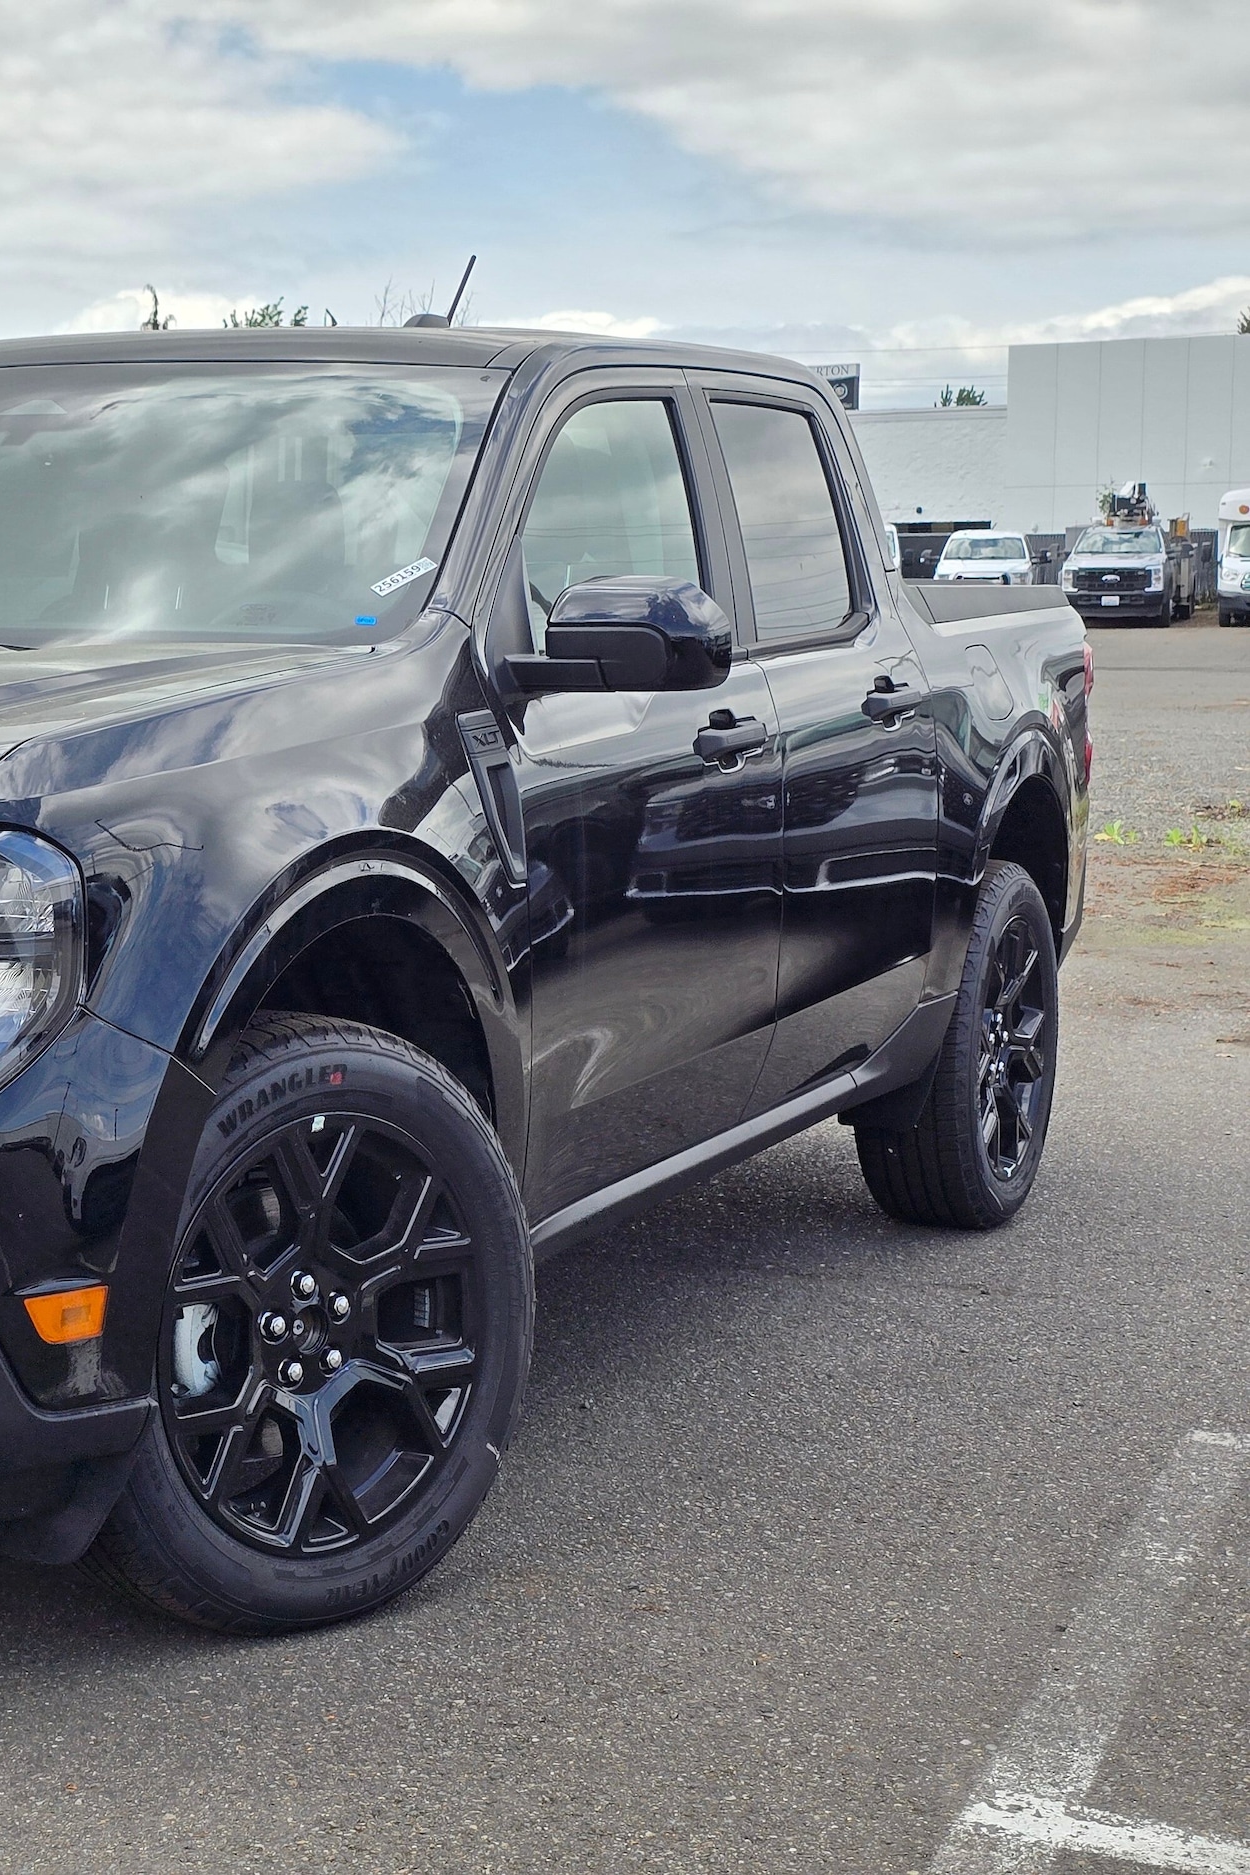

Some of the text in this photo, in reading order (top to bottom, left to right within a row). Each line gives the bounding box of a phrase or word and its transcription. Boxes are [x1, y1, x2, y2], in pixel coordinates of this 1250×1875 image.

[374, 565, 421, 592] 256159
[472, 730, 500, 748] XLT
[216, 1064, 347, 1138] WRANGLER
